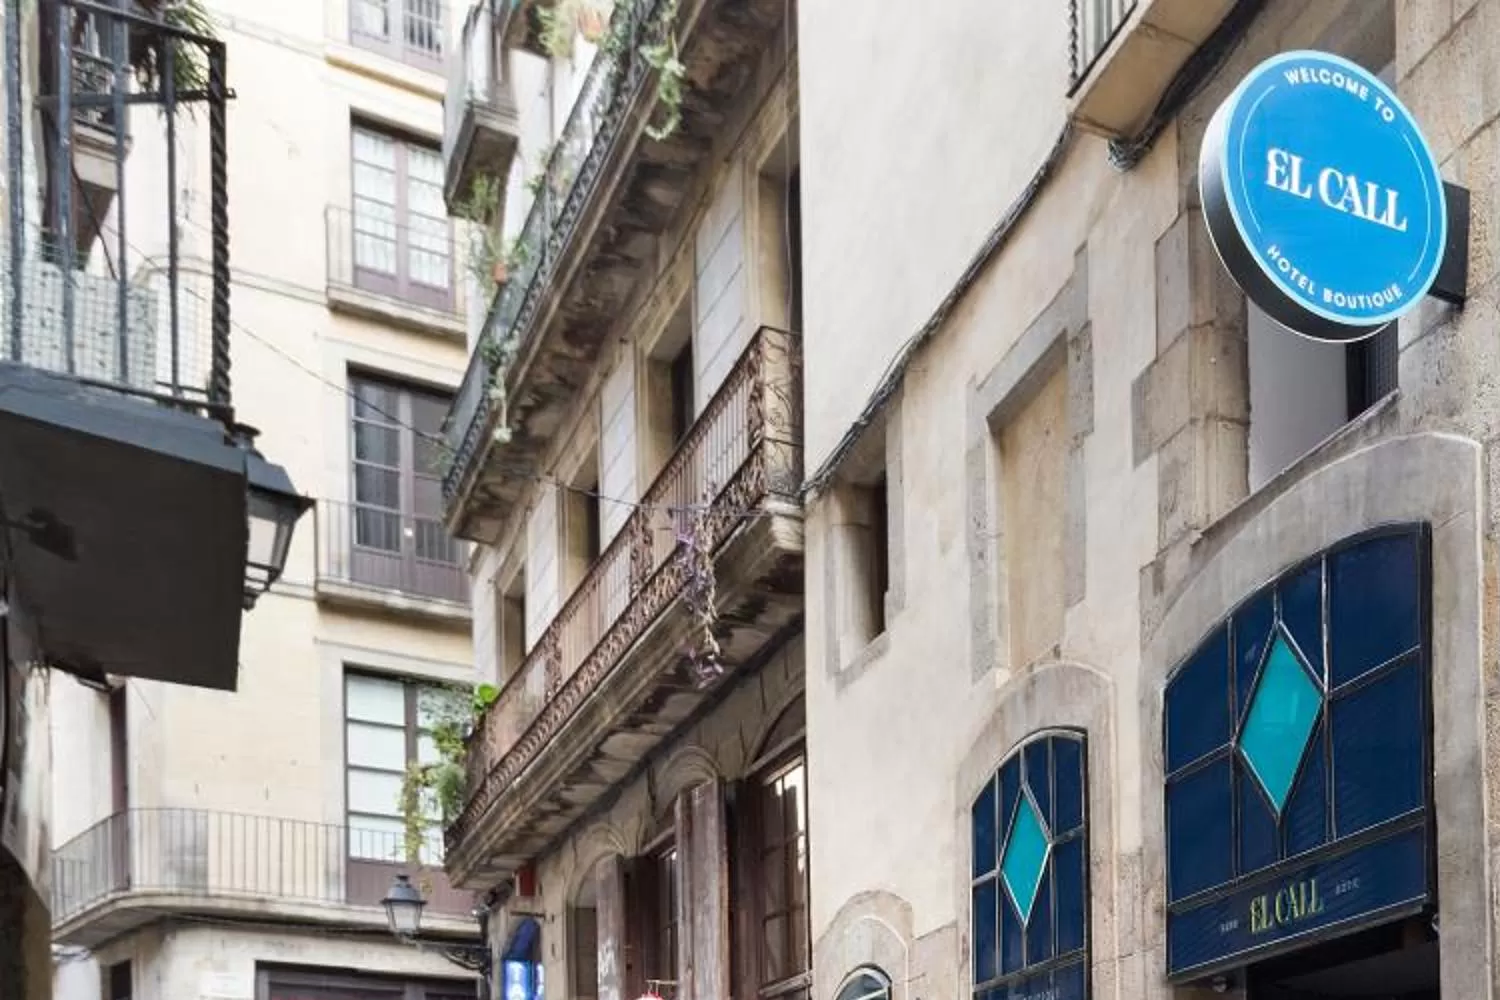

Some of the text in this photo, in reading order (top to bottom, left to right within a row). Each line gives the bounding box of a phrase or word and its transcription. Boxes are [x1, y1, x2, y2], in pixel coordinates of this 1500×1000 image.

[1283, 67, 1396, 123] WELCOME TO
[1264, 147, 1408, 233] EL CALL
[1266, 244, 1404, 309] HOTEL BOUTIQUE
[1249, 894, 1274, 934] EL
[1274, 878, 1325, 924] CALL
